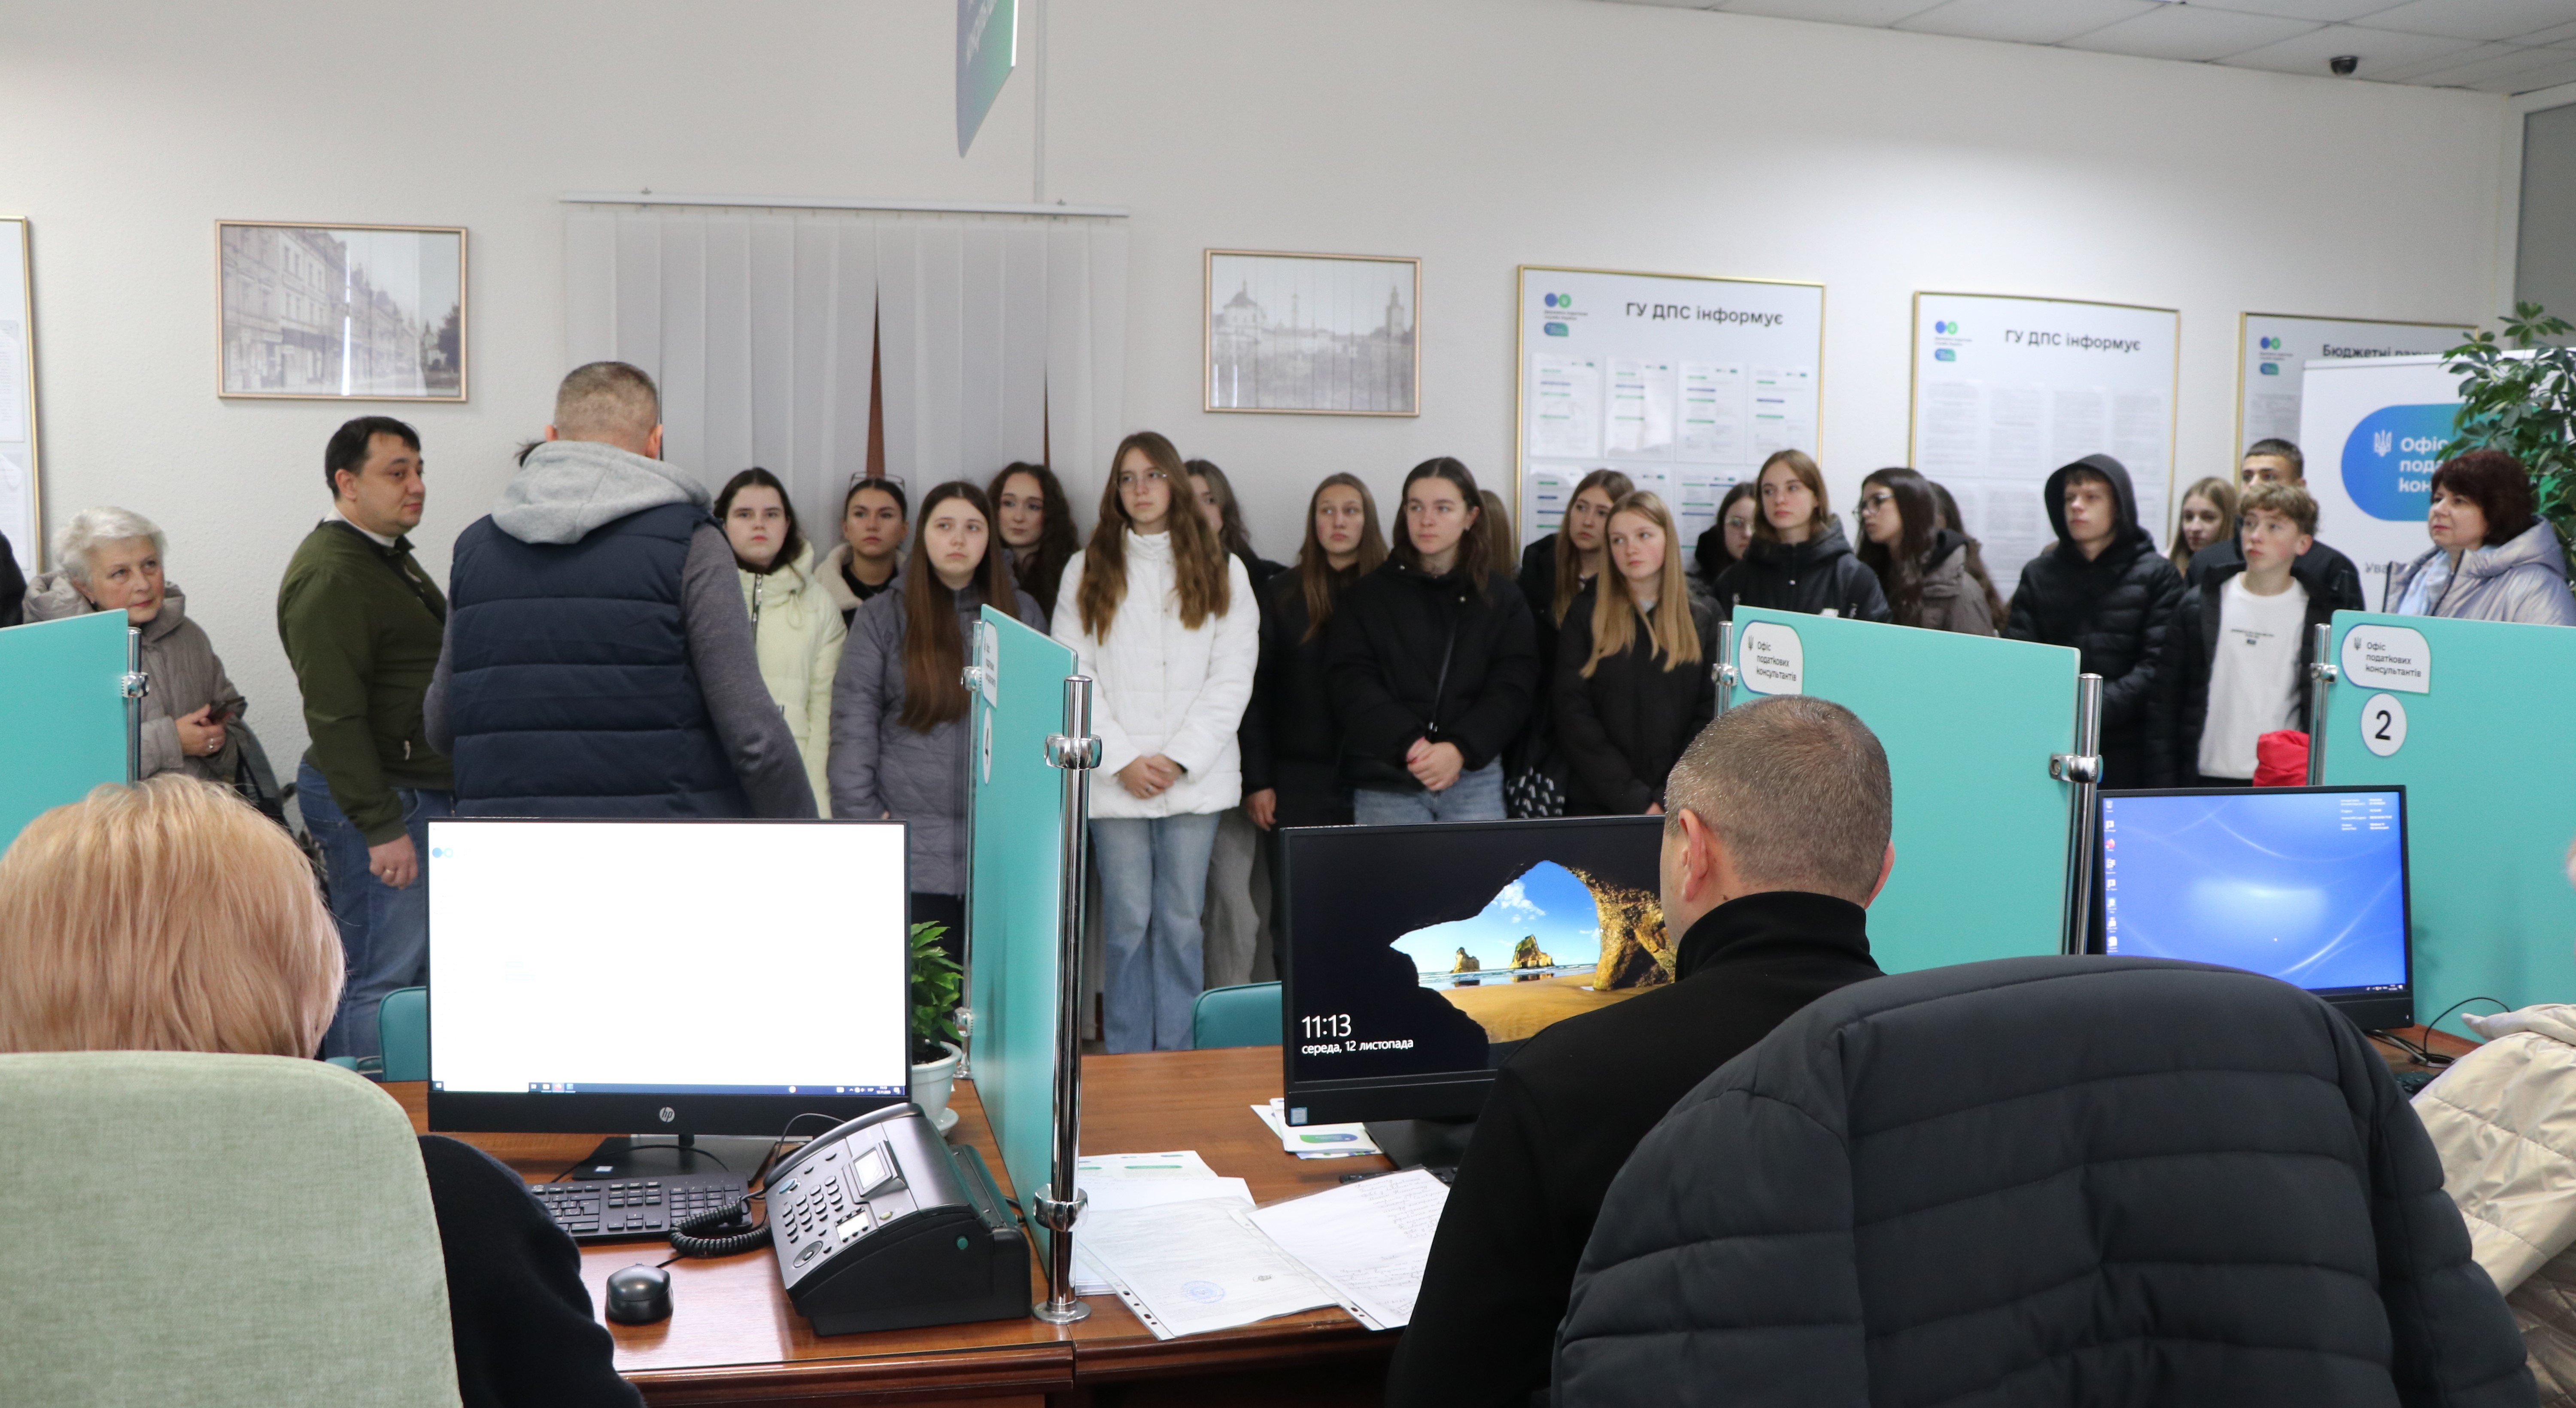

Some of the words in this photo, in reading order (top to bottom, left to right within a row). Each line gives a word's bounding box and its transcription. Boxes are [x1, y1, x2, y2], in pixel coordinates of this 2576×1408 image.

[1626, 302, 1647, 316] ГУ
[1653, 304, 1690, 320] ДПС
[1697, 306, 1783, 326] інформує
[2005, 330, 2023, 343] ГУ
[2028, 331, 2061, 347] ДПС
[2066, 333, 2141, 353] інформує
[1757, 641, 1771, 652] Офіс
[2366, 642, 2386, 652] Офіс
[1756, 655, 1790, 667] податкових
[2366, 654, 2412, 665] податкових
[1756, 666, 1797, 681] консультантів
[2365, 664, 2421, 678] консультантів
[2375, 709, 2392, 741] 2
[1301, 1014, 1352, 1038] 11:13
[1301, 1043, 1343, 1056] середа,
[1345, 1040, 1357, 1052] 12
[1359, 1039, 1414, 1051] листопада
[661, 1107, 674, 1122] hp
